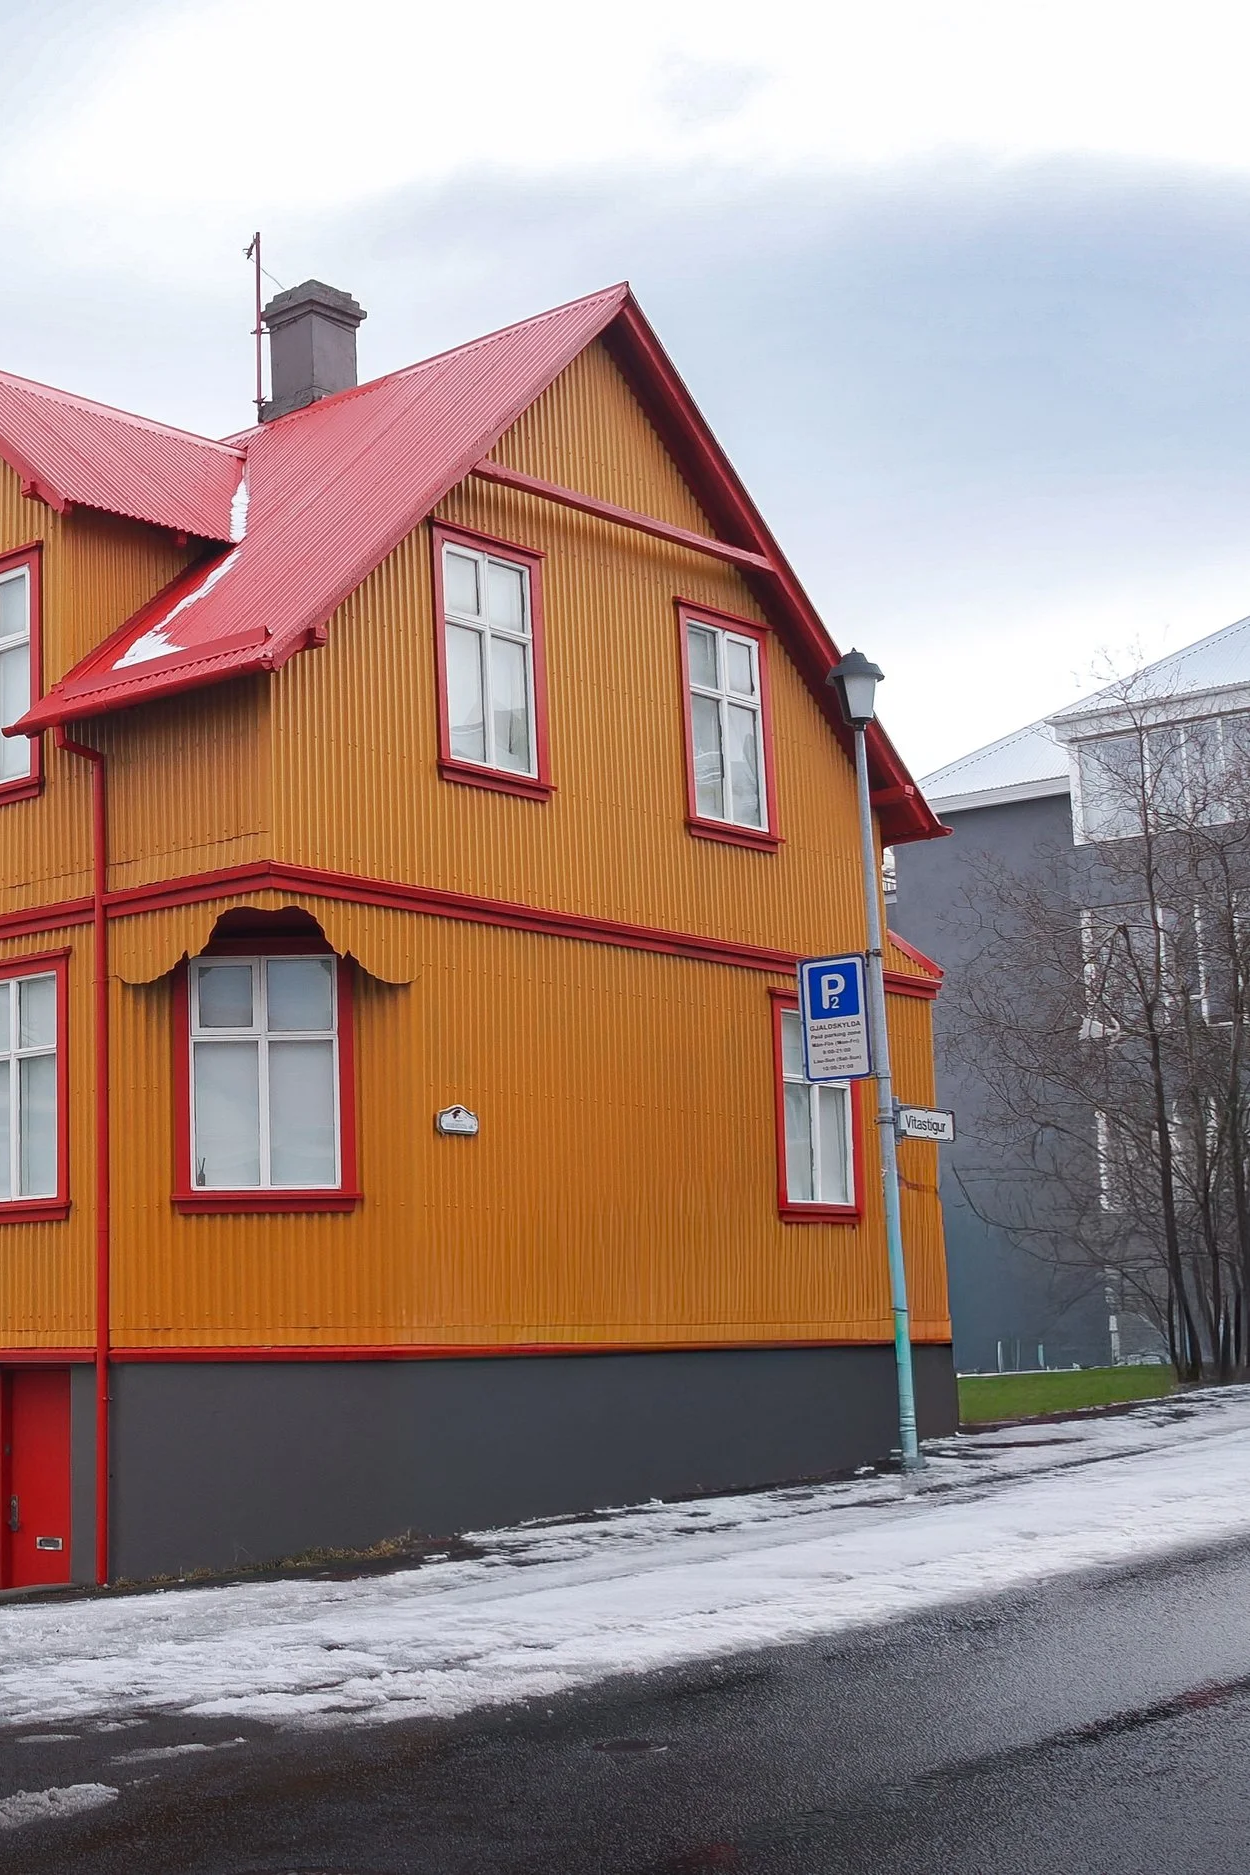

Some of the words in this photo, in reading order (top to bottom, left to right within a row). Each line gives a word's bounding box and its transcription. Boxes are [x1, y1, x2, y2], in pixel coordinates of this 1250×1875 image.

[820, 973, 845, 1010] P
[830, 996, 840, 1009] 2
[810, 1020, 861, 1031] GJALDSKYLDA
